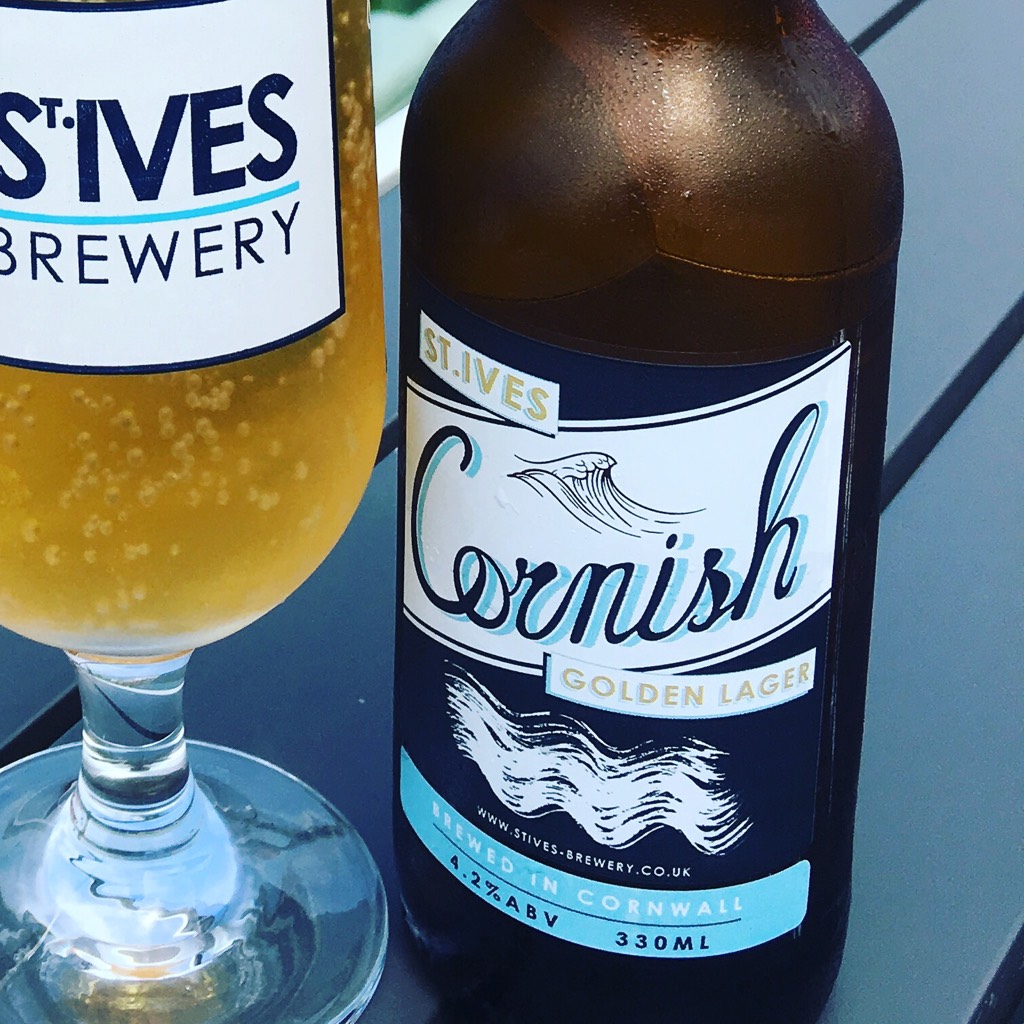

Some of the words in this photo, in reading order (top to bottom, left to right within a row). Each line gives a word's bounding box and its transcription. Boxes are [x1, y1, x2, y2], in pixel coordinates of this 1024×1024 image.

[410, 401, 827, 647] Cornish
[561, 667, 705, 708] GOLDEN
[719, 661, 811, 706] LAGER
[431, 800, 515, 875] BREWED
[529, 872, 559, 897] IN
[576, 886, 744, 918] CORNWALL
[476, 804, 692, 878] WWW.STIVES-BREWERY.CO.UK
[614, 931, 710, 952] 330ML
